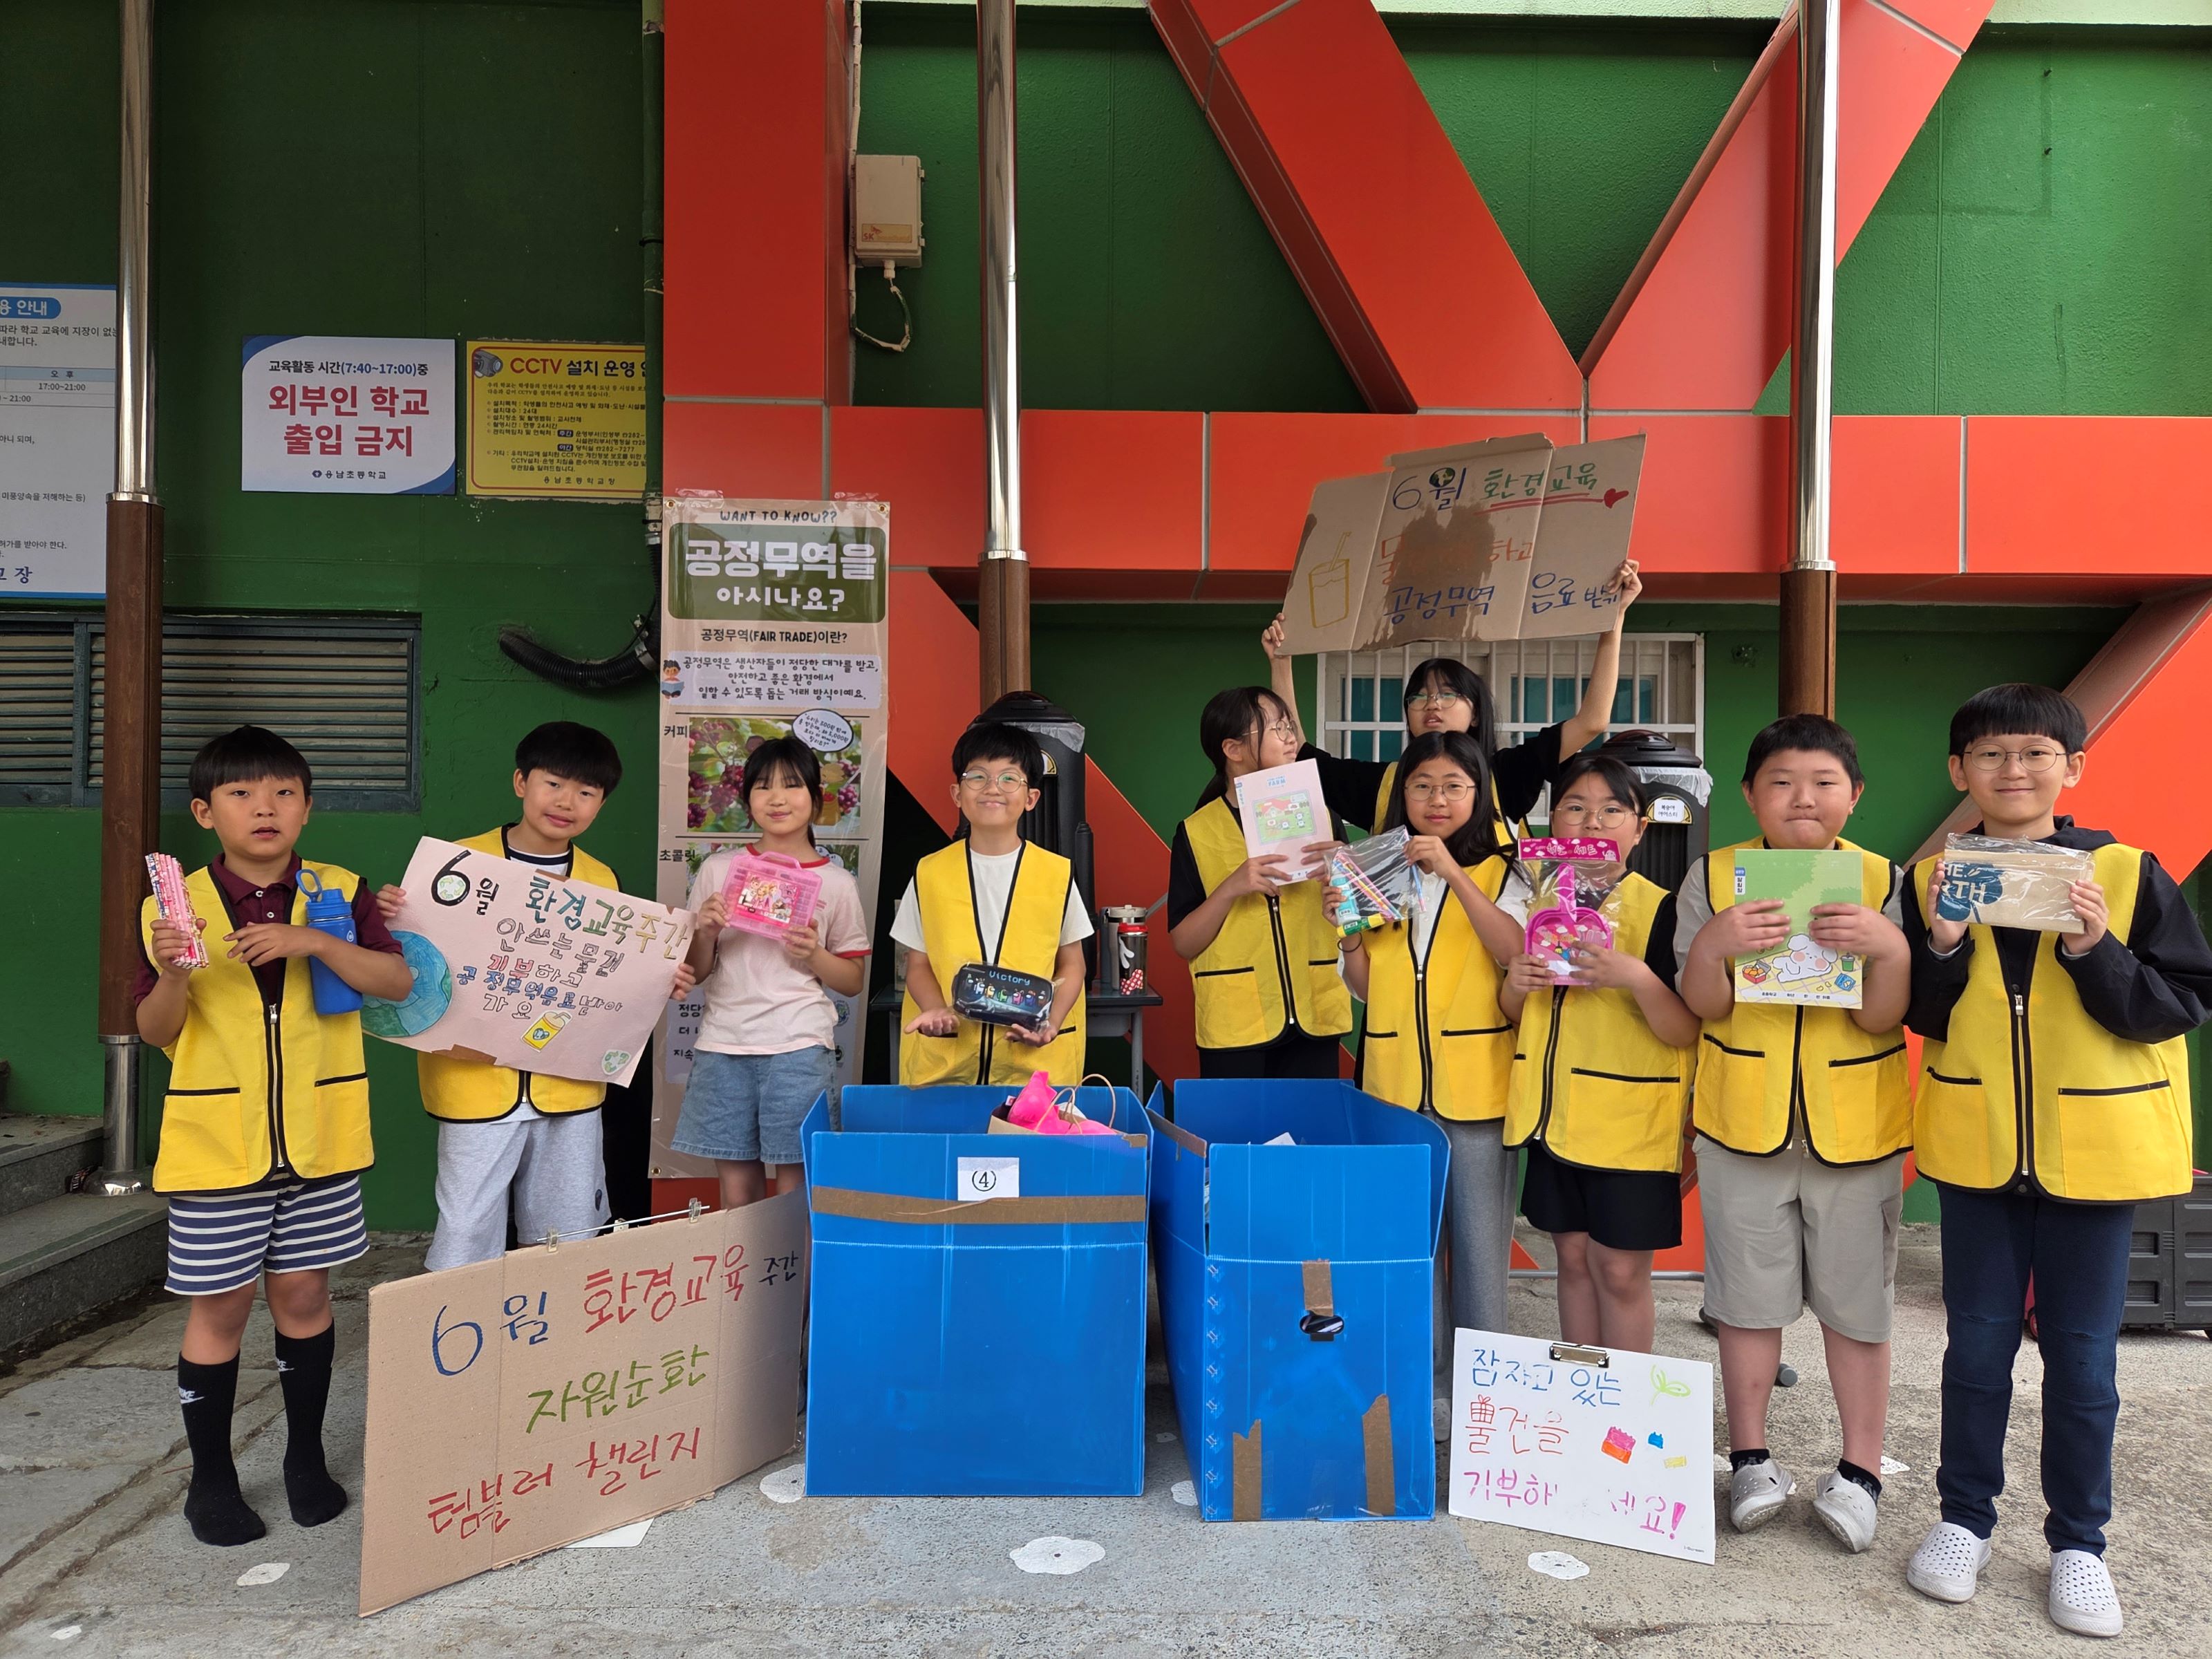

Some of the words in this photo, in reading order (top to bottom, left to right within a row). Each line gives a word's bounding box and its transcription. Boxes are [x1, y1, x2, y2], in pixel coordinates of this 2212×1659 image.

[863, 232, 874, 241] SK
[17, 299, 48, 317] 안내
[21, 325, 39, 335] 학교
[41, 326, 68, 336] 교육에
[72, 326, 100, 337] 지장이
[268, 360, 315, 374] 교육활동
[318, 361, 429, 377] 시간(7:40~17:00)중
[510, 357, 563, 375] CCTV
[566, 359, 599, 377] 설치
[603, 360, 635, 379] 운영
[38, 382, 86, 392] 17:00~21:00
[10, 394, 32, 403] 21:00
[268, 384, 358, 418] 외부인
[369, 385, 430, 418] 학교
[17, 435, 35, 444] 되며,
[283, 423, 342, 456] 출입
[355, 424, 413, 458] 금지
[325, 469, 387, 480] 용남초등학교
[1392, 467, 1468, 512] 6월
[1479, 462, 1599, 501] 환경교육
[2, 492, 40, 501] 미풍양속을
[42, 493, 73, 502] 저해하는
[75, 494, 86, 503] 등)
[720, 510, 756, 523] WANT
[762, 511, 779, 522] TO
[784, 510, 838, 525] KNOW??
[24, 541, 47, 550] 받아야
[50, 541, 67, 550] 한다.
[685, 540, 877, 581] 공정무역을
[716, 586, 845, 612] 아시나요?
[1382, 585, 1496, 625] 공정무역
[1531, 572, 1577, 615] 음료
[700, 628, 776, 644] 공정무역(FAIR
[779, 630, 848, 644] TRADE)이란?
[683, 657, 732, 669] 공정무역은
[735, 657, 785, 671] 생산자들이
[789, 659, 819, 671] 정당한
[822, 659, 853, 673] 대가를
[856, 660, 879, 673] 받고,
[728, 672, 767, 684] 안전하고
[771, 673, 790, 685] 좋은
[792, 673, 834, 686] 환경에서
[698, 686, 718, 700] 일할
[721, 686, 731, 696] 수
[735, 686, 763, 700] 있도록
[767, 687, 786, 700] 돕는
[790, 688, 809, 697] 거래
[664, 725, 688, 738] 커피
[659, 849, 696, 863] 초콜릿
[1942, 863, 1968, 879] HE.
[431, 849, 500, 917] 6월
[496, 917, 572, 959] 안쓰는
[574, 941, 626, 978] 물건
[487, 953, 583, 988] 기부하고
[989, 970, 1031, 986] Victory
[678, 1004, 705, 1018] 정당
[679, 1026, 691, 1035] 더
[432, 1291, 550, 1377] 6월
[583, 1244, 750, 1333] 환경교육
[758, 1250, 801, 1286] 주간
[1471, 1349, 1554, 1393] 잠자고
[1570, 1369, 1622, 1407] 있는
[525, 1343, 710, 1434] 자원순환
[427, 1463, 553, 1540] 텀블러
[574, 1426, 702, 1497] 챌린지
